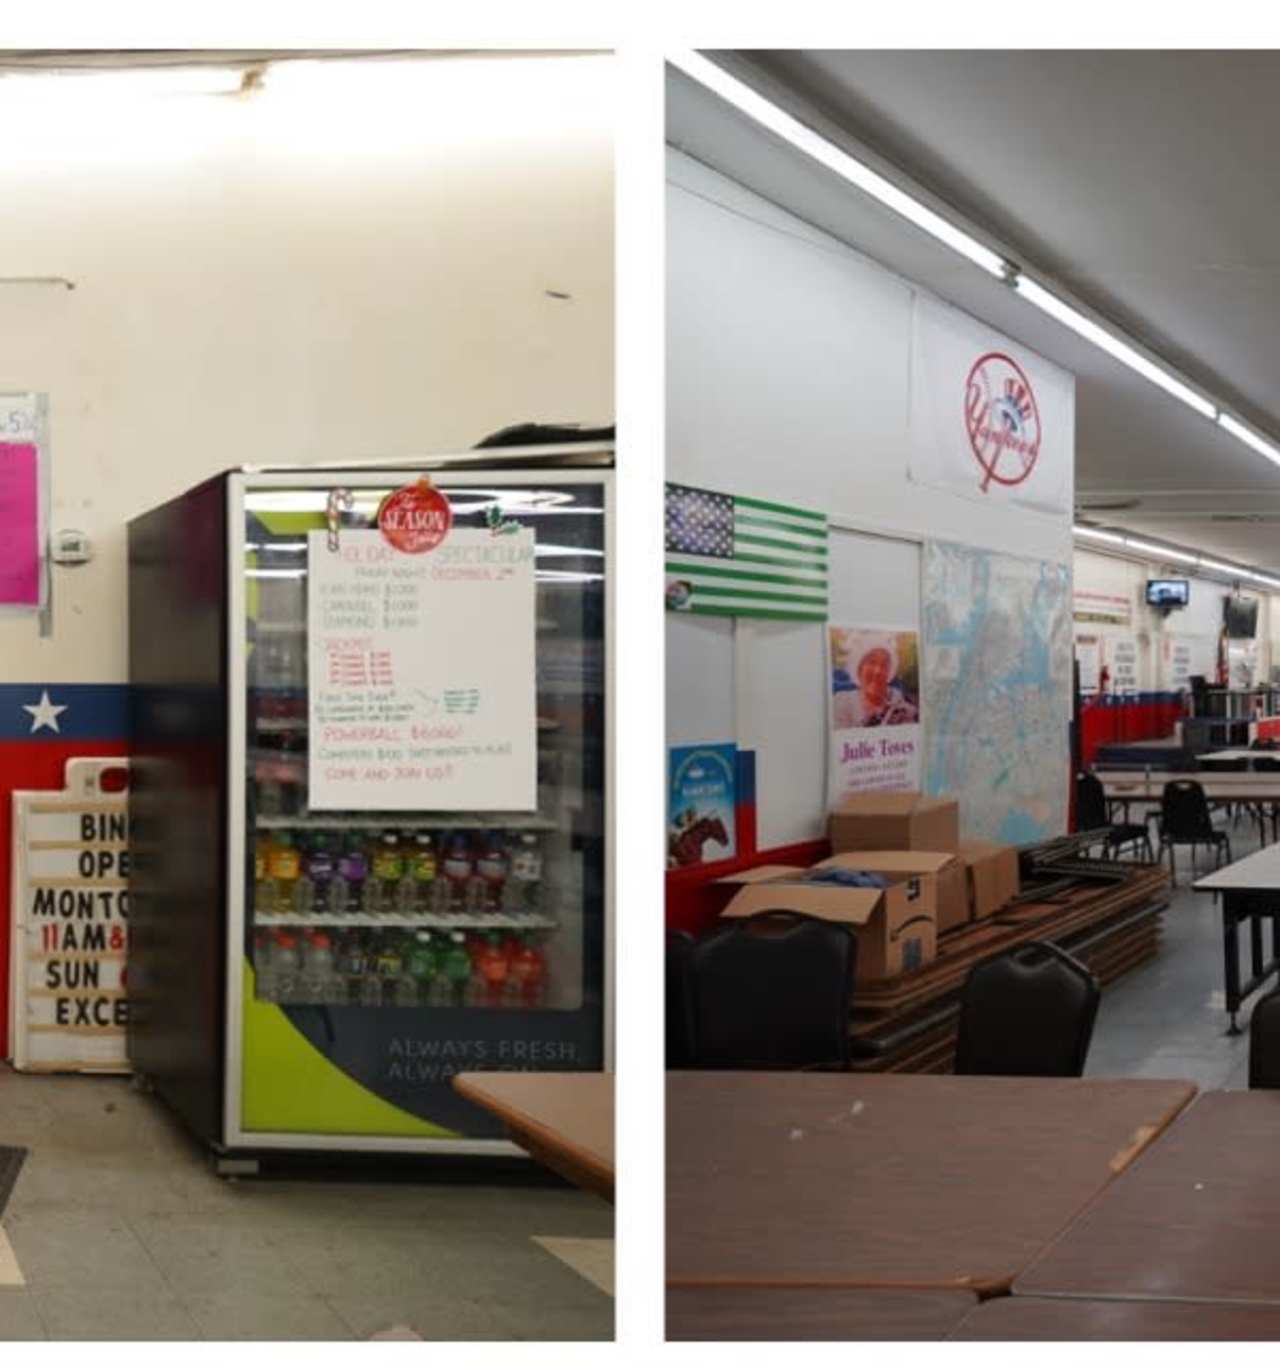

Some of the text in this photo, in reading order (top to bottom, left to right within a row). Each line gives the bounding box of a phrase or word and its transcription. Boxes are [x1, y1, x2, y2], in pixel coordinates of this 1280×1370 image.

[382, 510, 445, 531] SEASON
[46, 959, 100, 989] SUN
[388, 1038, 488, 1059] ALWAYS
